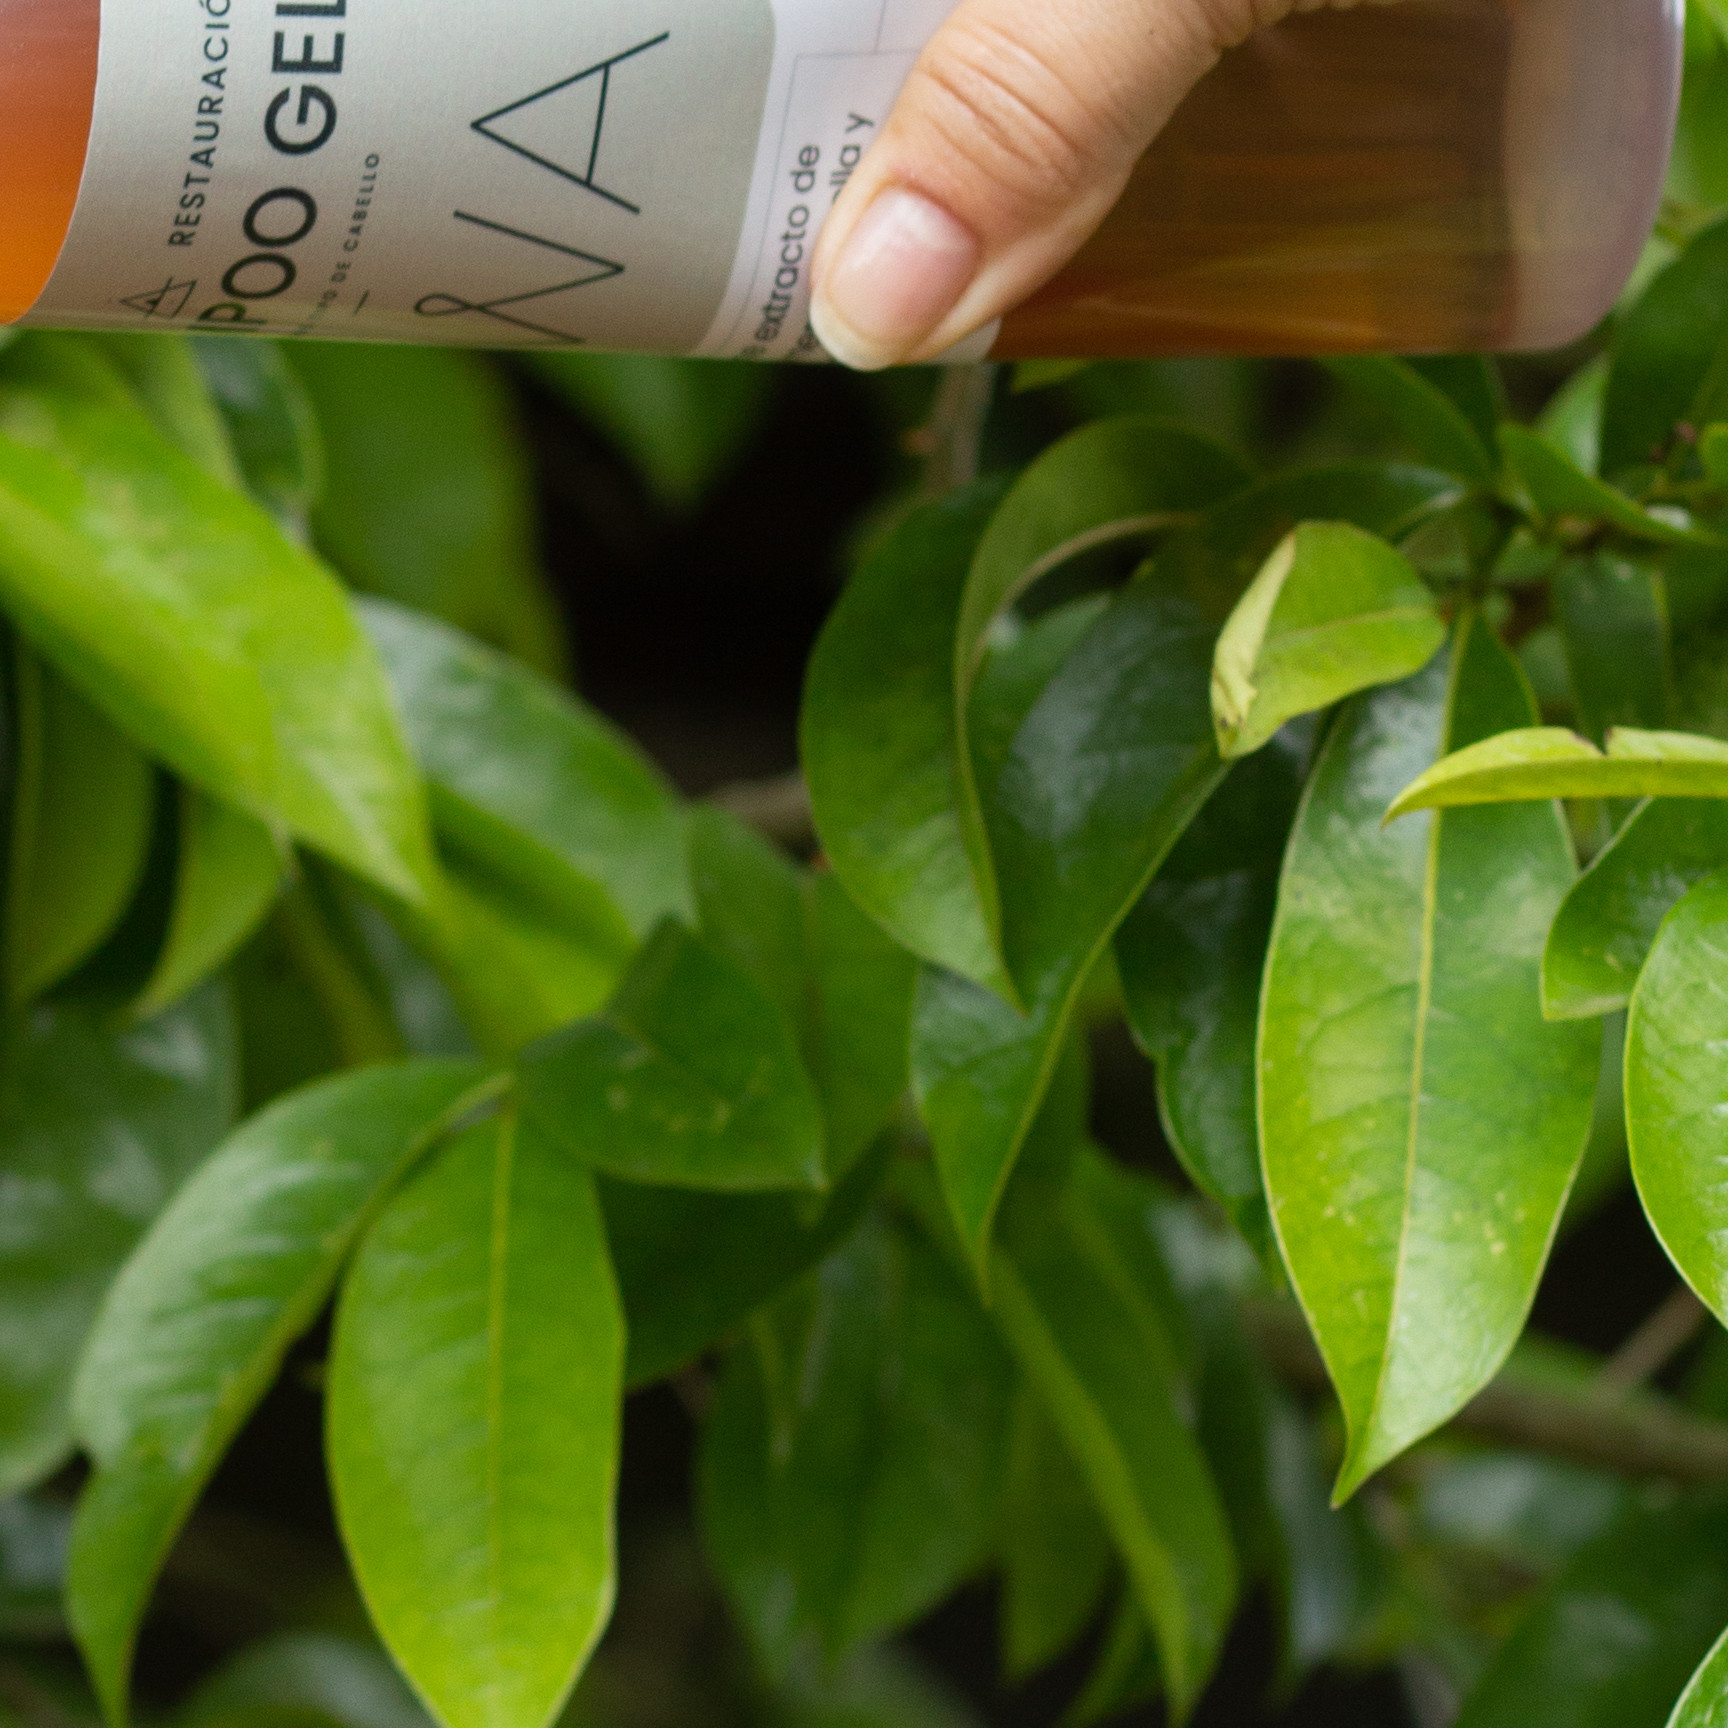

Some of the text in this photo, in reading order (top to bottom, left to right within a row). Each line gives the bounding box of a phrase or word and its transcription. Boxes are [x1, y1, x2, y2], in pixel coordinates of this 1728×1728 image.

[844, 111, 874, 134] y
[341, 151, 380, 252] CABELLO
[751, 143, 820, 341] extracto de
